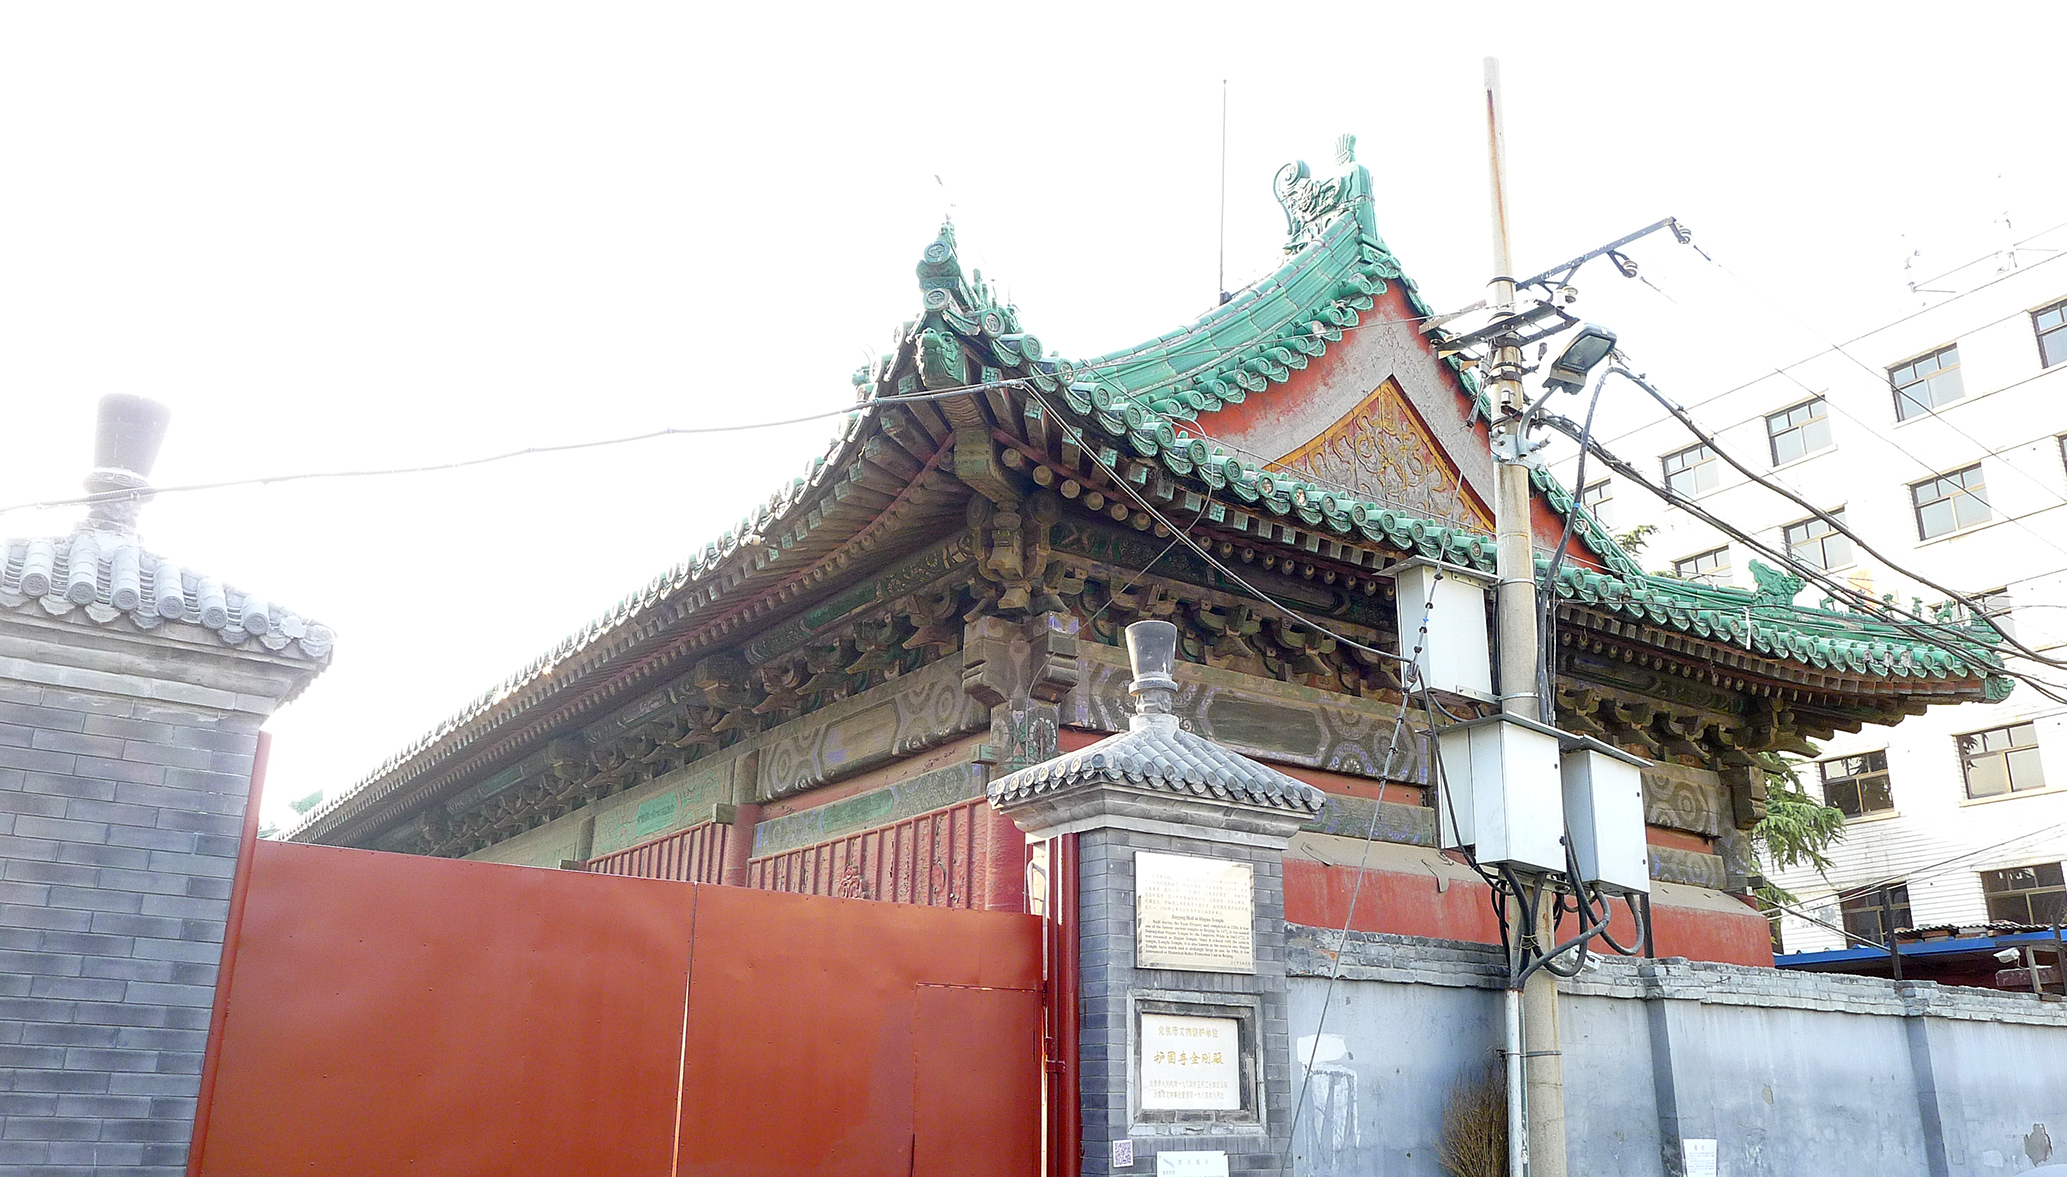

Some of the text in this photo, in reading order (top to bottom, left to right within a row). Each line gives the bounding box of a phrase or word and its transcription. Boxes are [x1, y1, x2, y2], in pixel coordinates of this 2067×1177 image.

[1158, 1025, 1219, 1038] 北京市文物保护单位
[1154, 1050, 1224, 1066] 护国寺金刚殿
